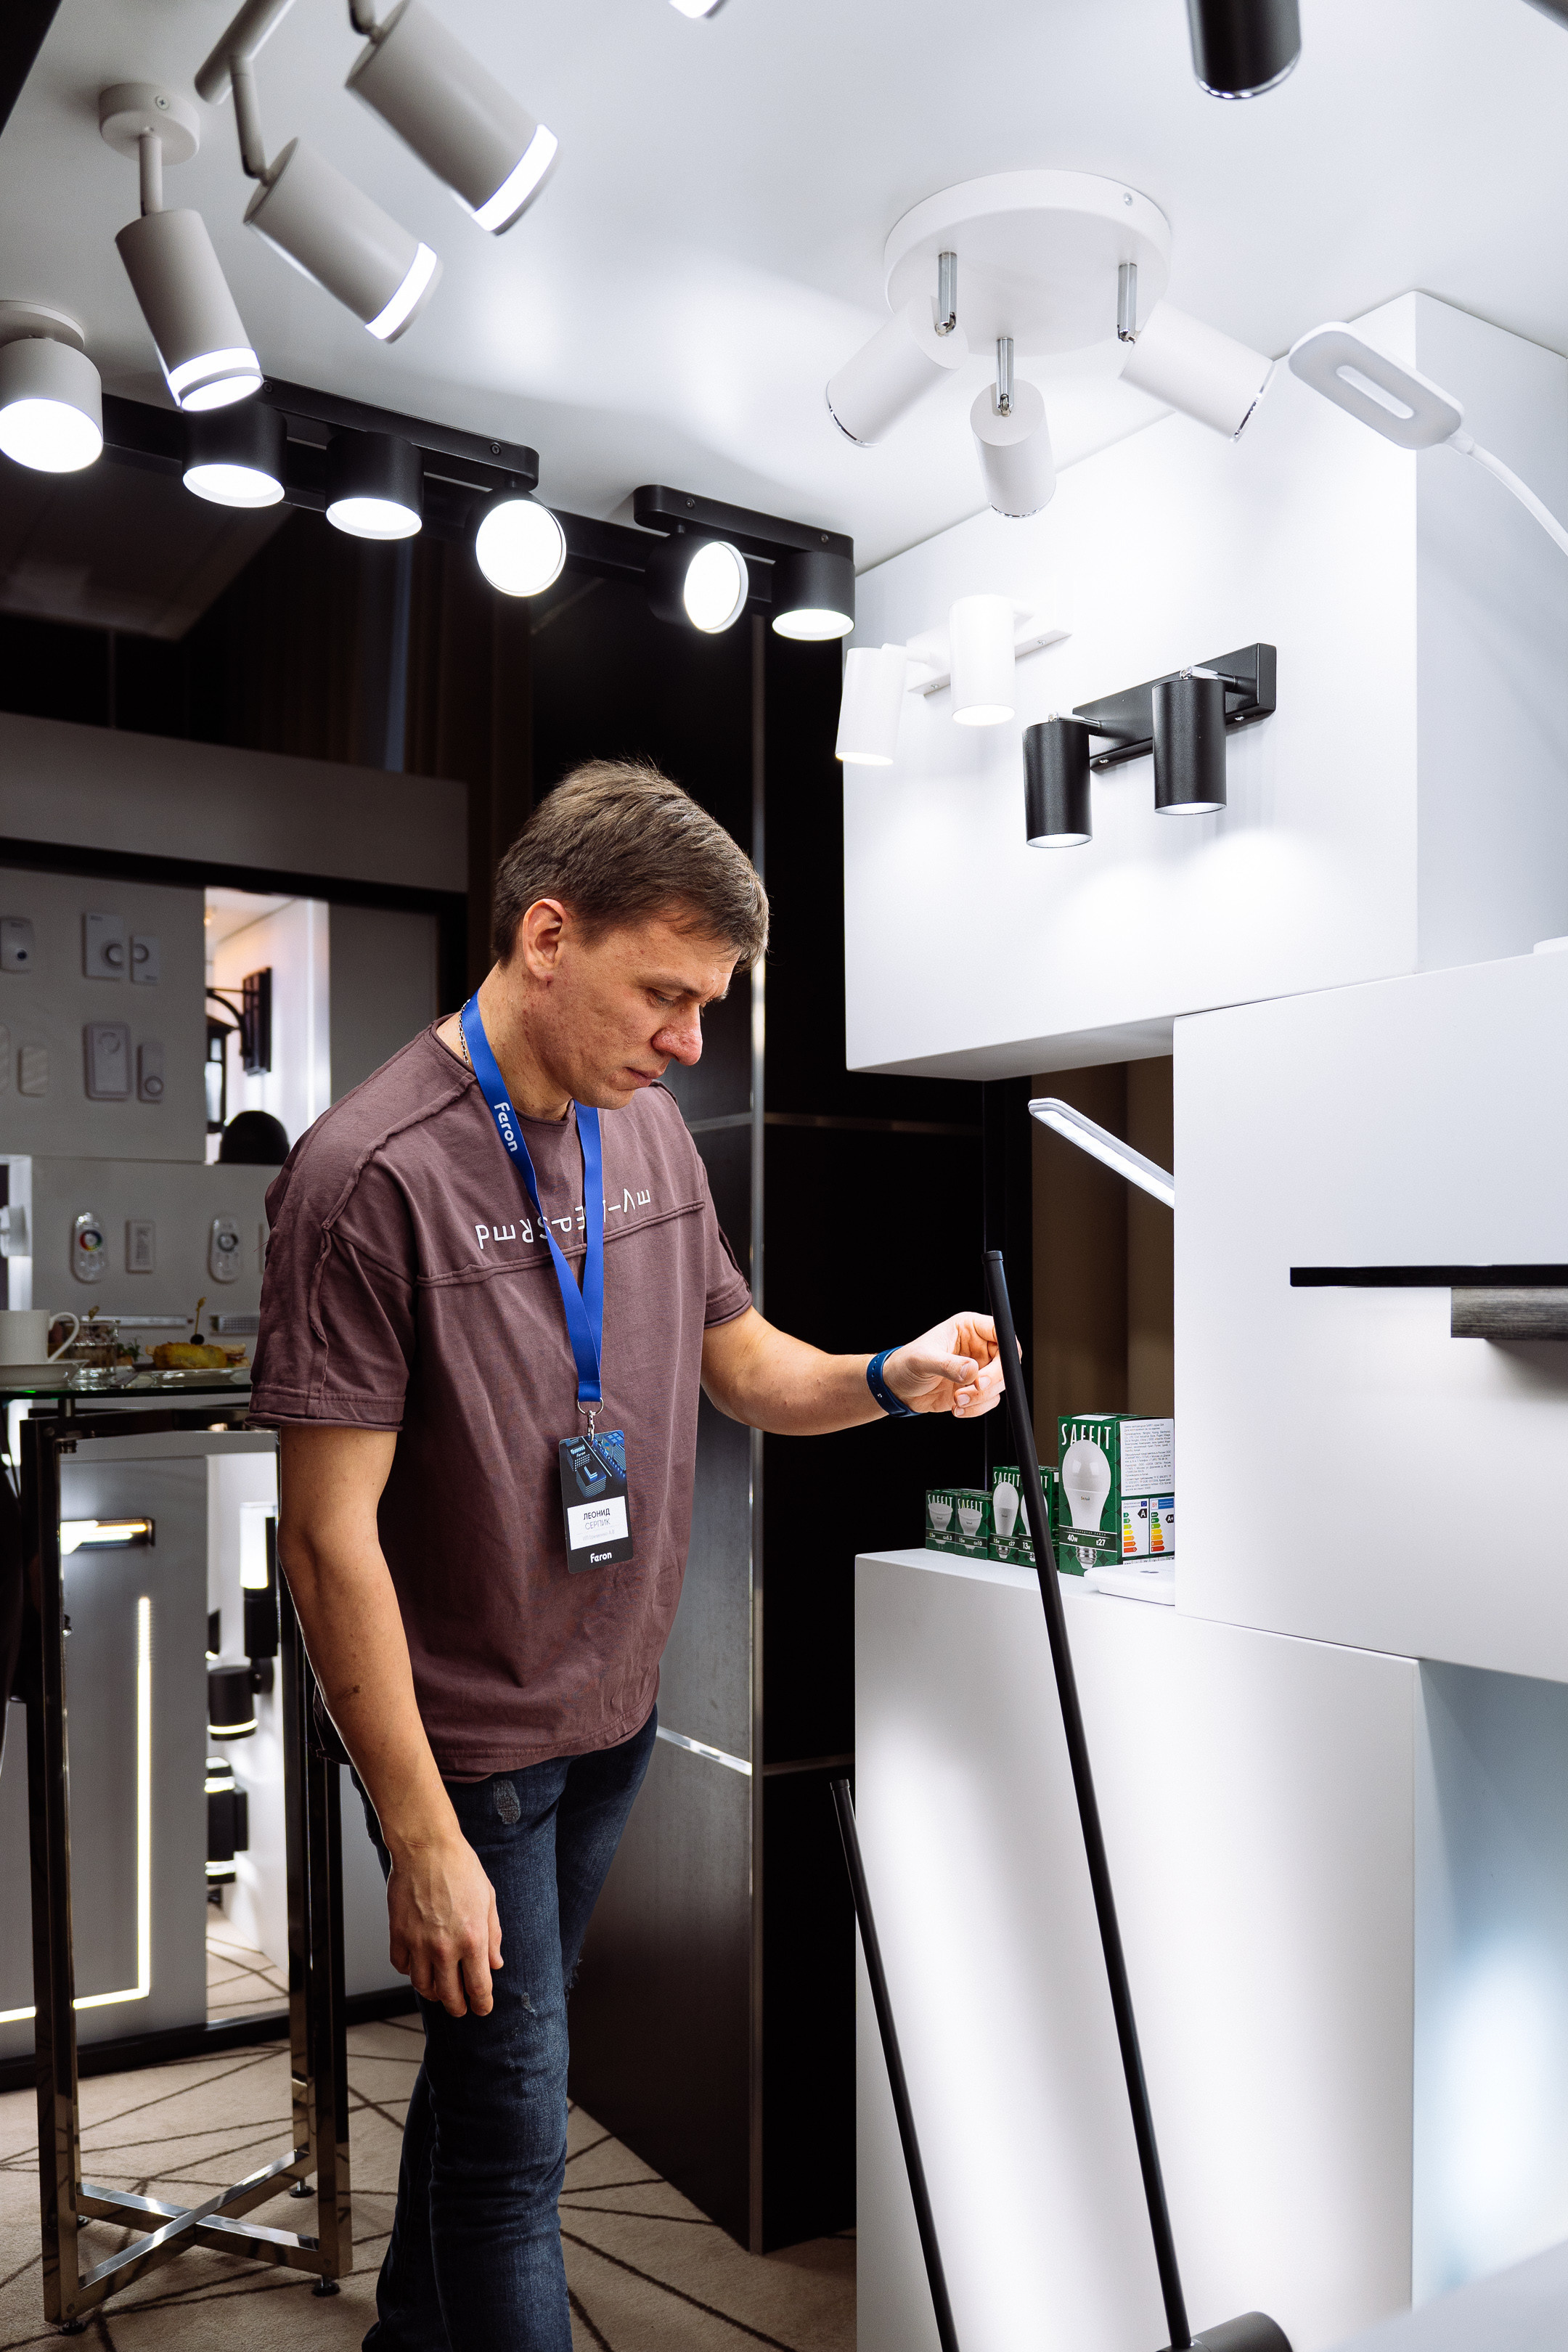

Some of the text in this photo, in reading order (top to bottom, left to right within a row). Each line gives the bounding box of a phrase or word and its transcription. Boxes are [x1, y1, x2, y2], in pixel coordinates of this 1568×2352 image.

[494, 1102, 518, 1152] Feron
[1061, 1423, 1111, 1450] SAFFIT
[994, 1471, 1021, 1487] SAFFIT
[583, 1508, 611, 1521] ЛЕОНИД
[584, 1517, 611, 1530] СЕРПИК
[1067, 1534, 1078, 1543] 40W
[590, 1551, 613, 1564] Feron
